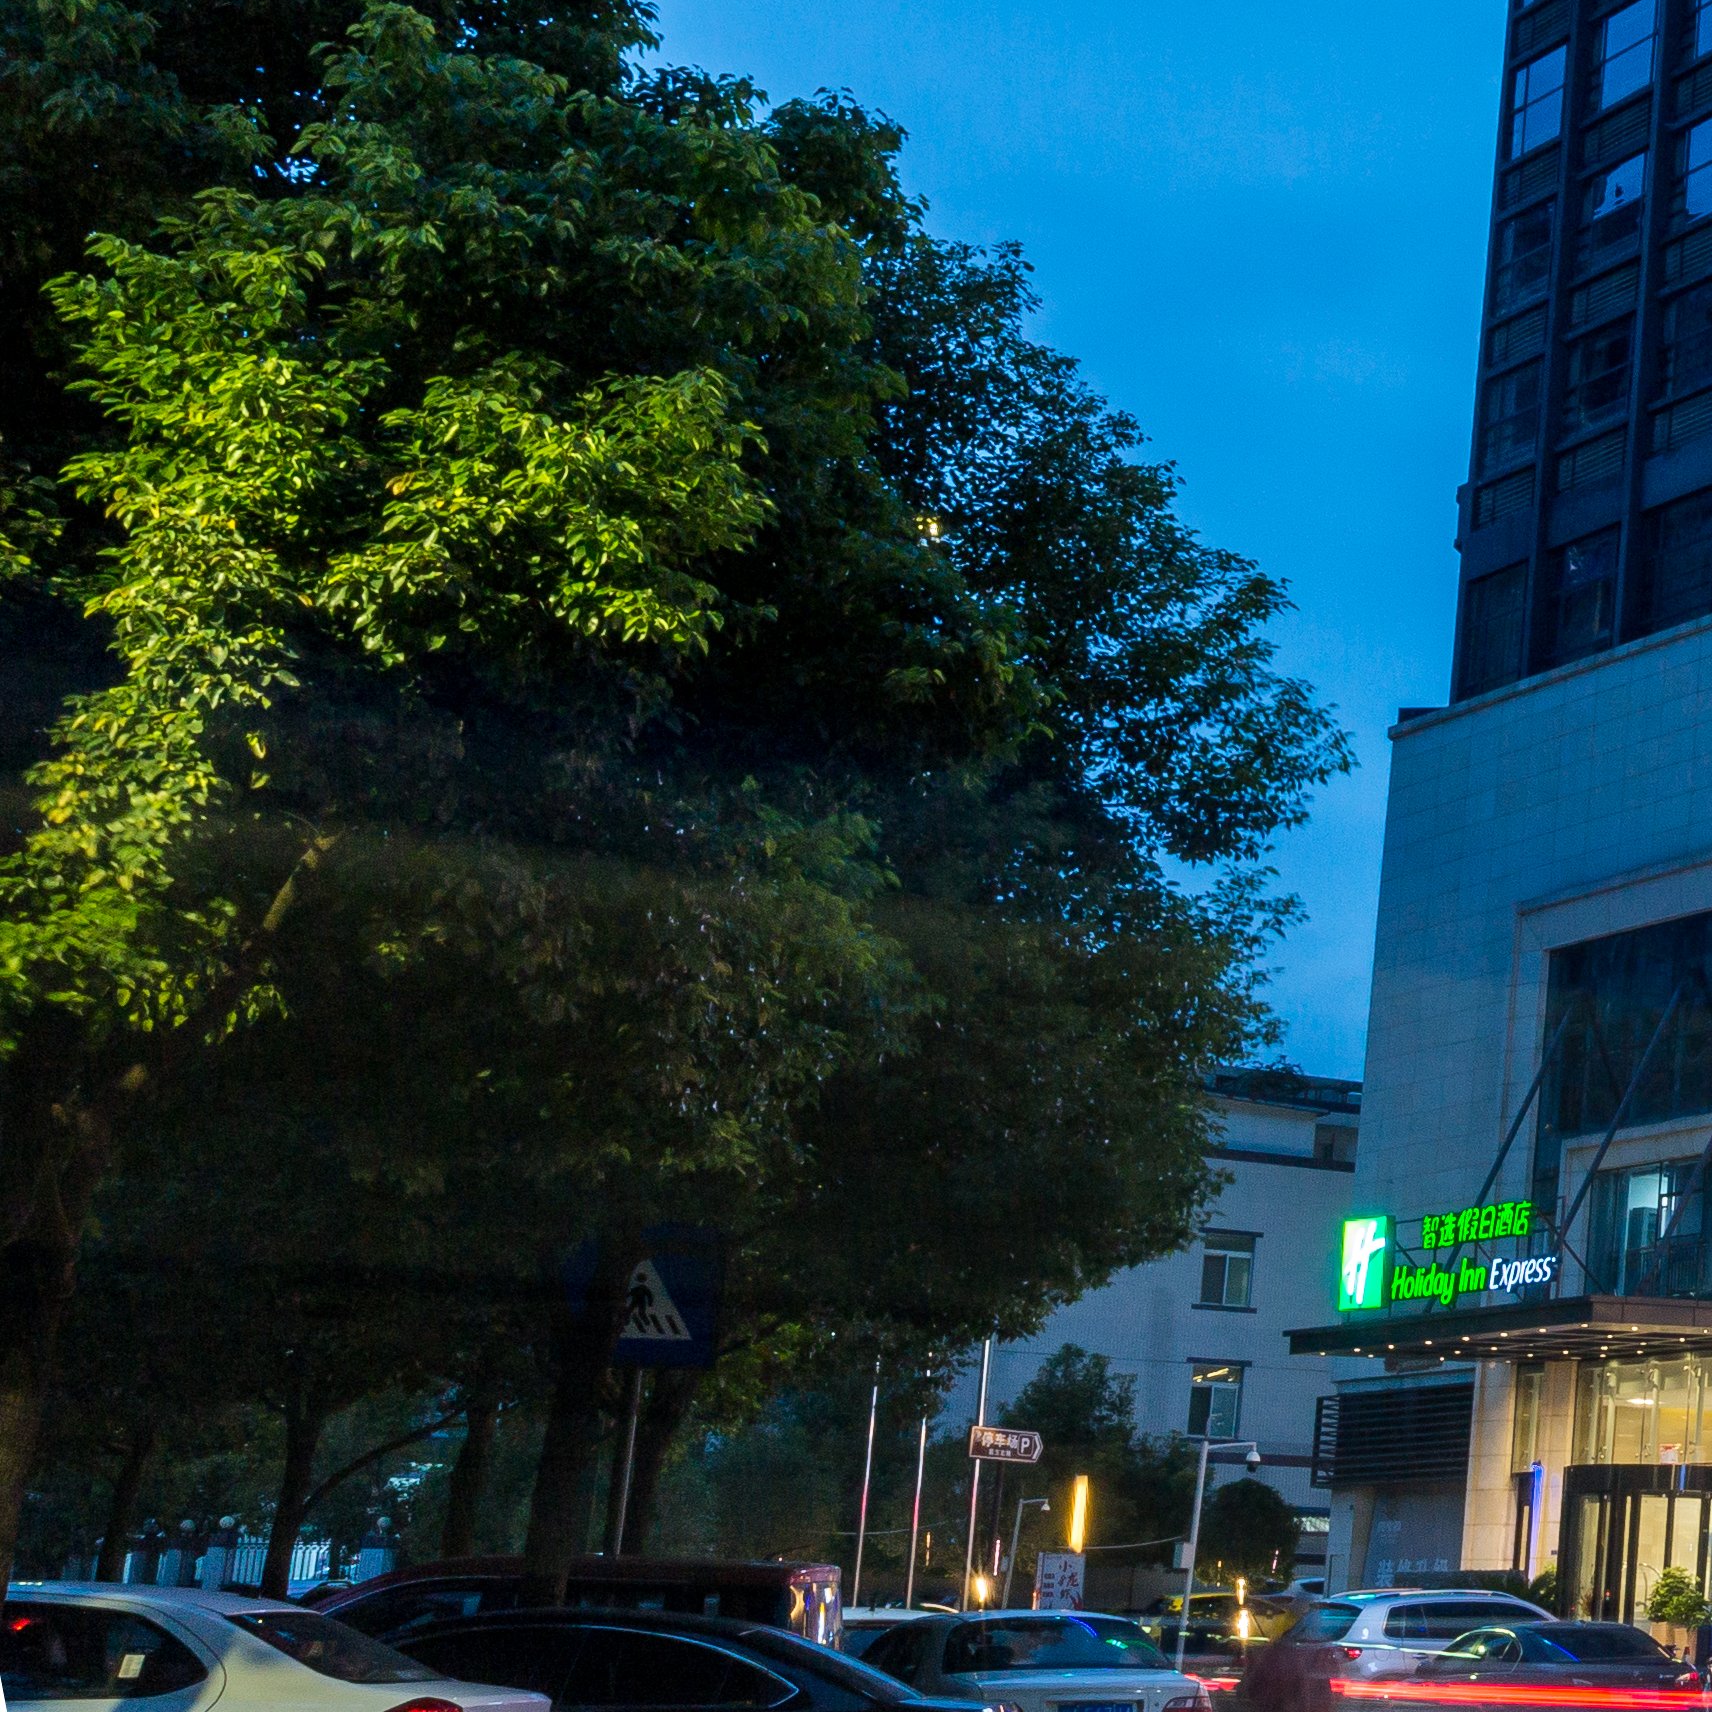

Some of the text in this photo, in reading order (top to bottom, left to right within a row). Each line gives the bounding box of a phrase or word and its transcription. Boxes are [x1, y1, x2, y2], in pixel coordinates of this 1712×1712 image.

[1423, 1200, 1532, 1249] 智选假日酒店
[1391, 1256, 1553, 1305] Holiday Inn Express
